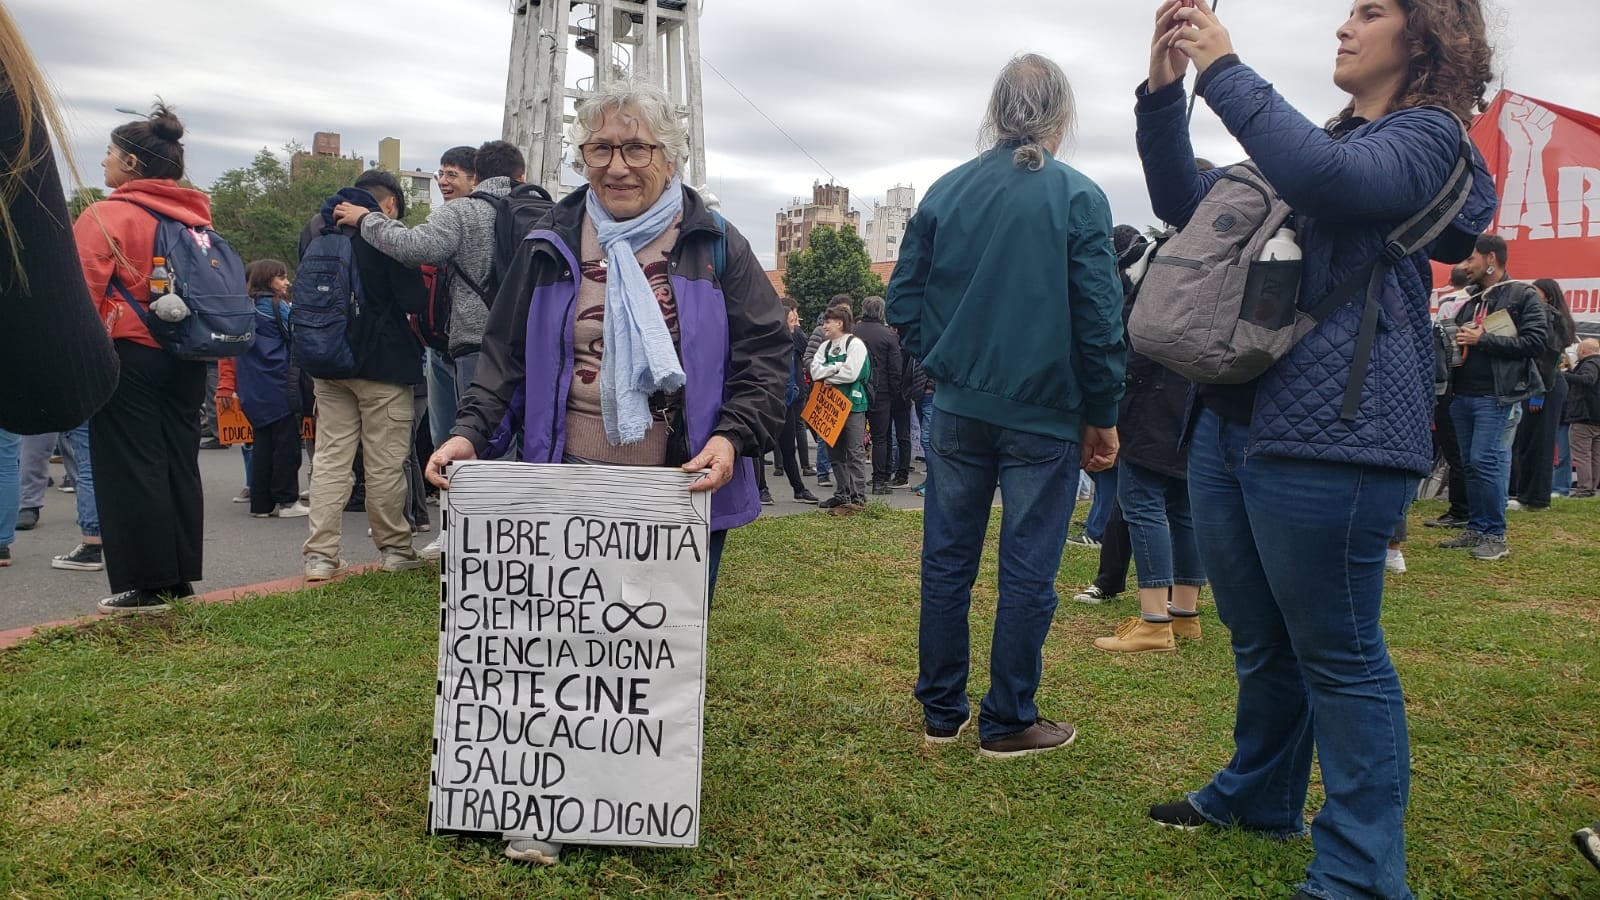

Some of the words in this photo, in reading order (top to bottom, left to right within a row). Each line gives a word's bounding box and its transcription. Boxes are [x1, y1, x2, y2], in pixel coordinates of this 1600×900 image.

[211, 332, 252, 343] HEAD
[808, 410, 831, 438] PRECIO
[815, 404, 823, 414] NO
[823, 409, 838, 428] TIENE
[563, 516, 702, 563] GRATUITA
[460, 557, 605, 602] PUBLICA
[453, 633, 578, 667] CIENCIA
[585, 638, 676, 670] DIGNA
[452, 667, 545, 709] ARTE
[554, 673, 650, 715] CINE
[450, 745, 566, 789] SALUD
[440, 787, 585, 841] TRABAJO
[590, 798, 694, 838] DIGNO
